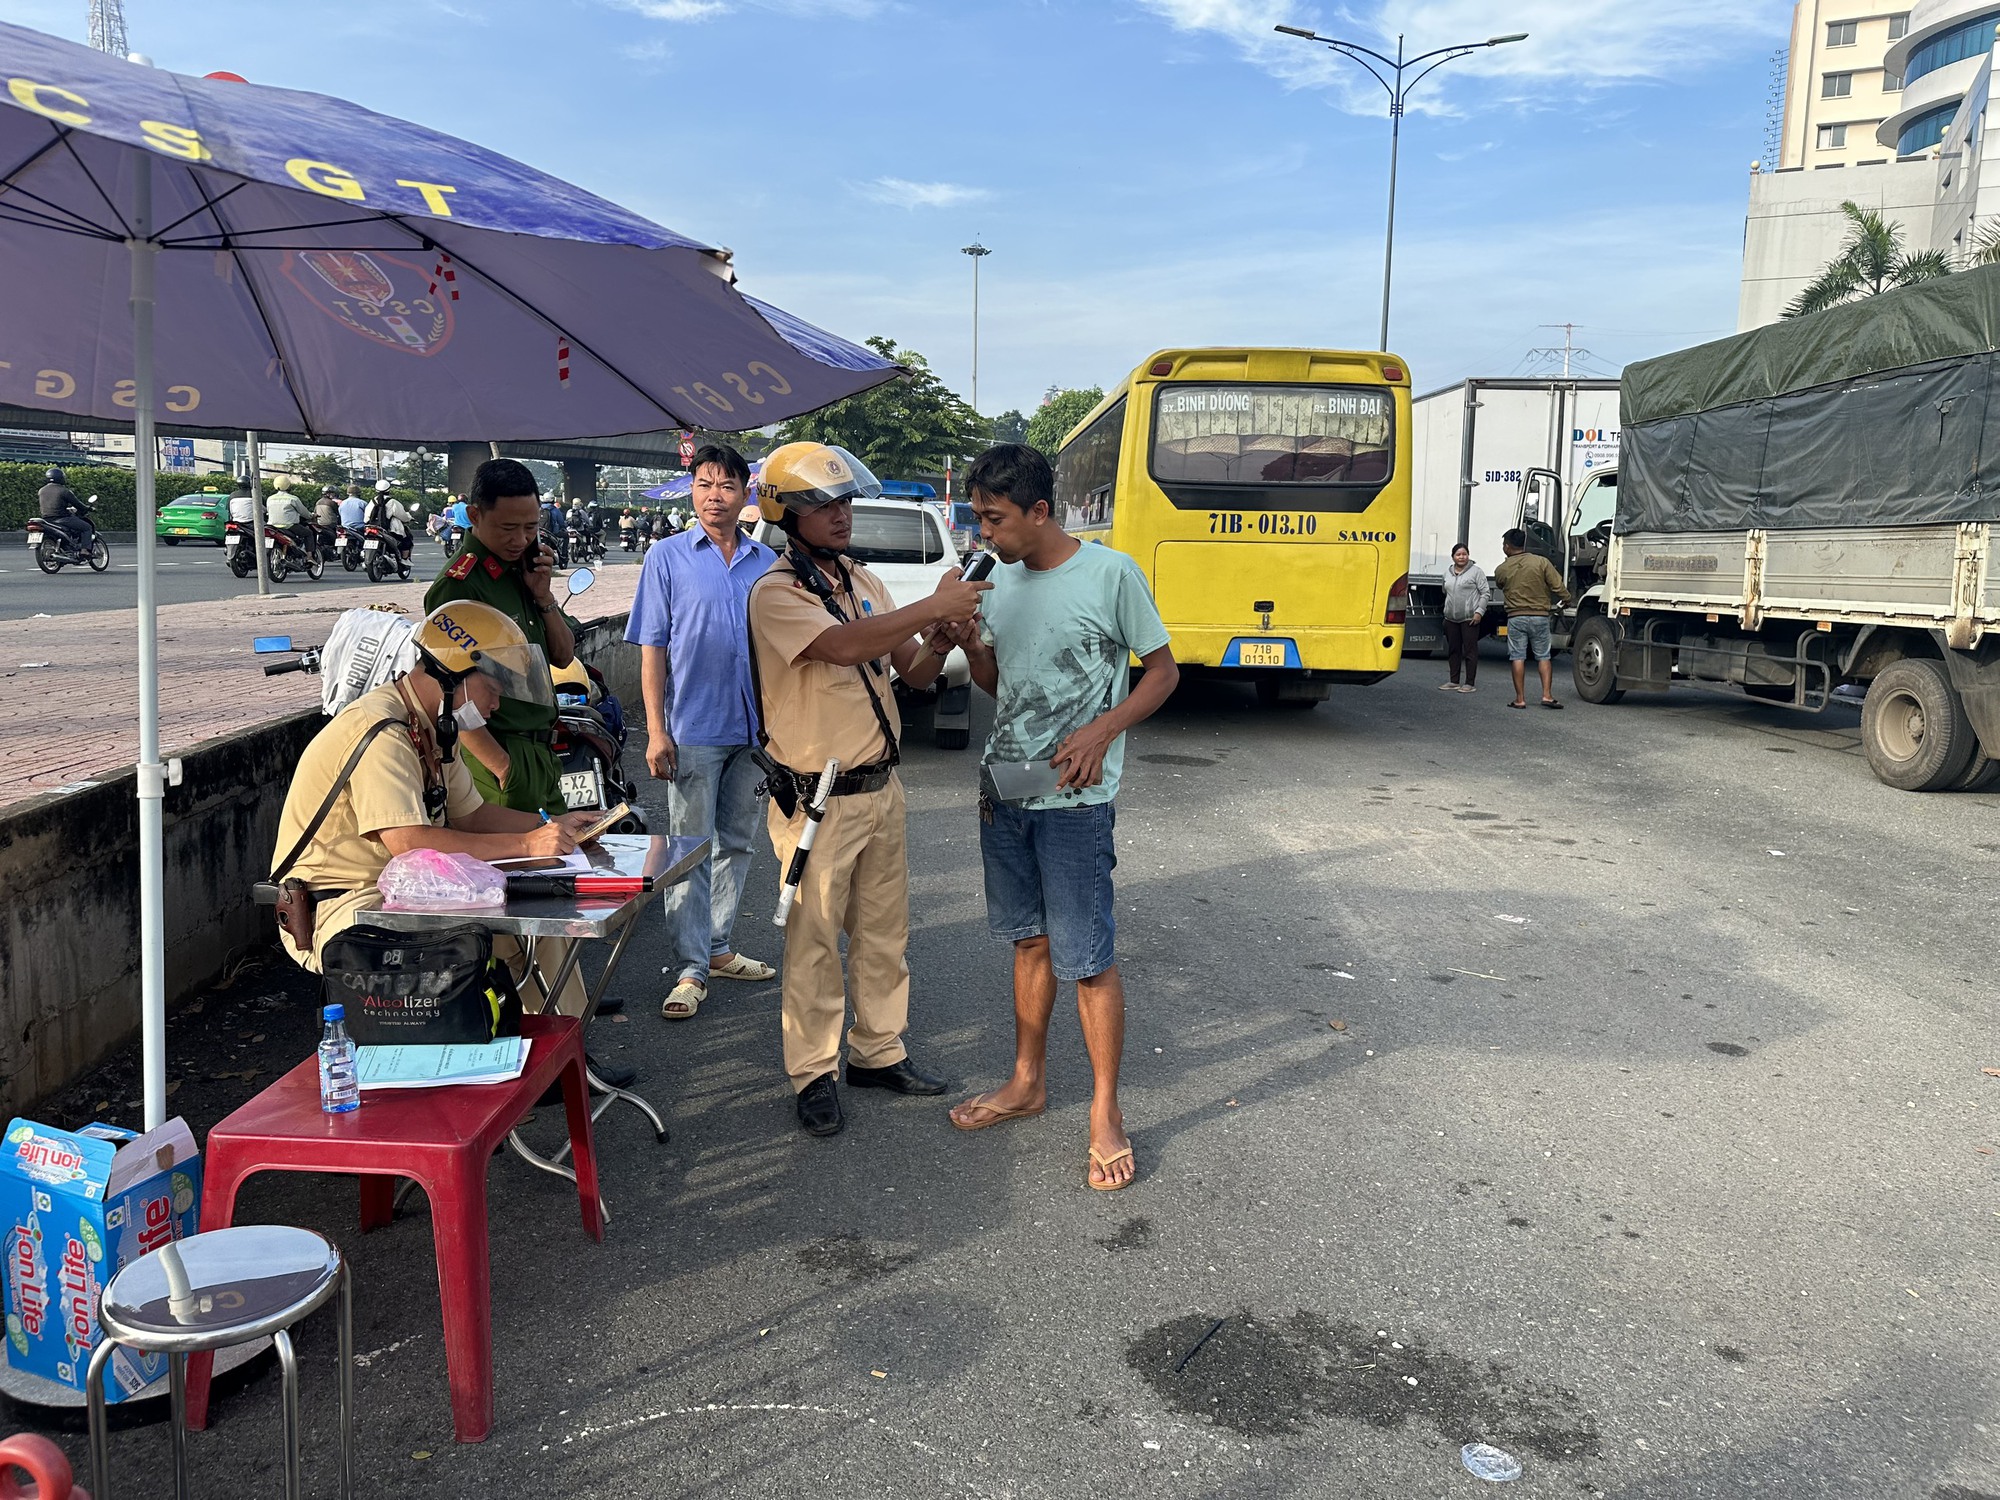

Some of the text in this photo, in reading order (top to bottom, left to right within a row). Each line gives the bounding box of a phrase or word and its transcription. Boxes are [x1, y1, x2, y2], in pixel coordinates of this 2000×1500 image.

[1328, 394, 1357, 414] BÌNH
[1360, 398, 1381, 417] ĐẠI
[1485, 470, 1522, 482] 51D-382
[1208, 513, 1243, 534] 71B
[1258, 513, 1317, 535] 013.10
[1338, 530, 1397, 542] SAMCO
[432, 613, 479, 651] CSGT
[1245, 655, 1280, 665] 013.10
[1253, 645, 1272, 654] 71B
[358, 995, 441, 1009] Alcolizer
[363, 1008, 441, 1018] technology
[19, 1142, 82, 1171] I-on Life
[139, 1195, 172, 1257] ife
[16, 1225, 43, 1336] I-on Life
[64, 1238, 93, 1350] I-on Life
